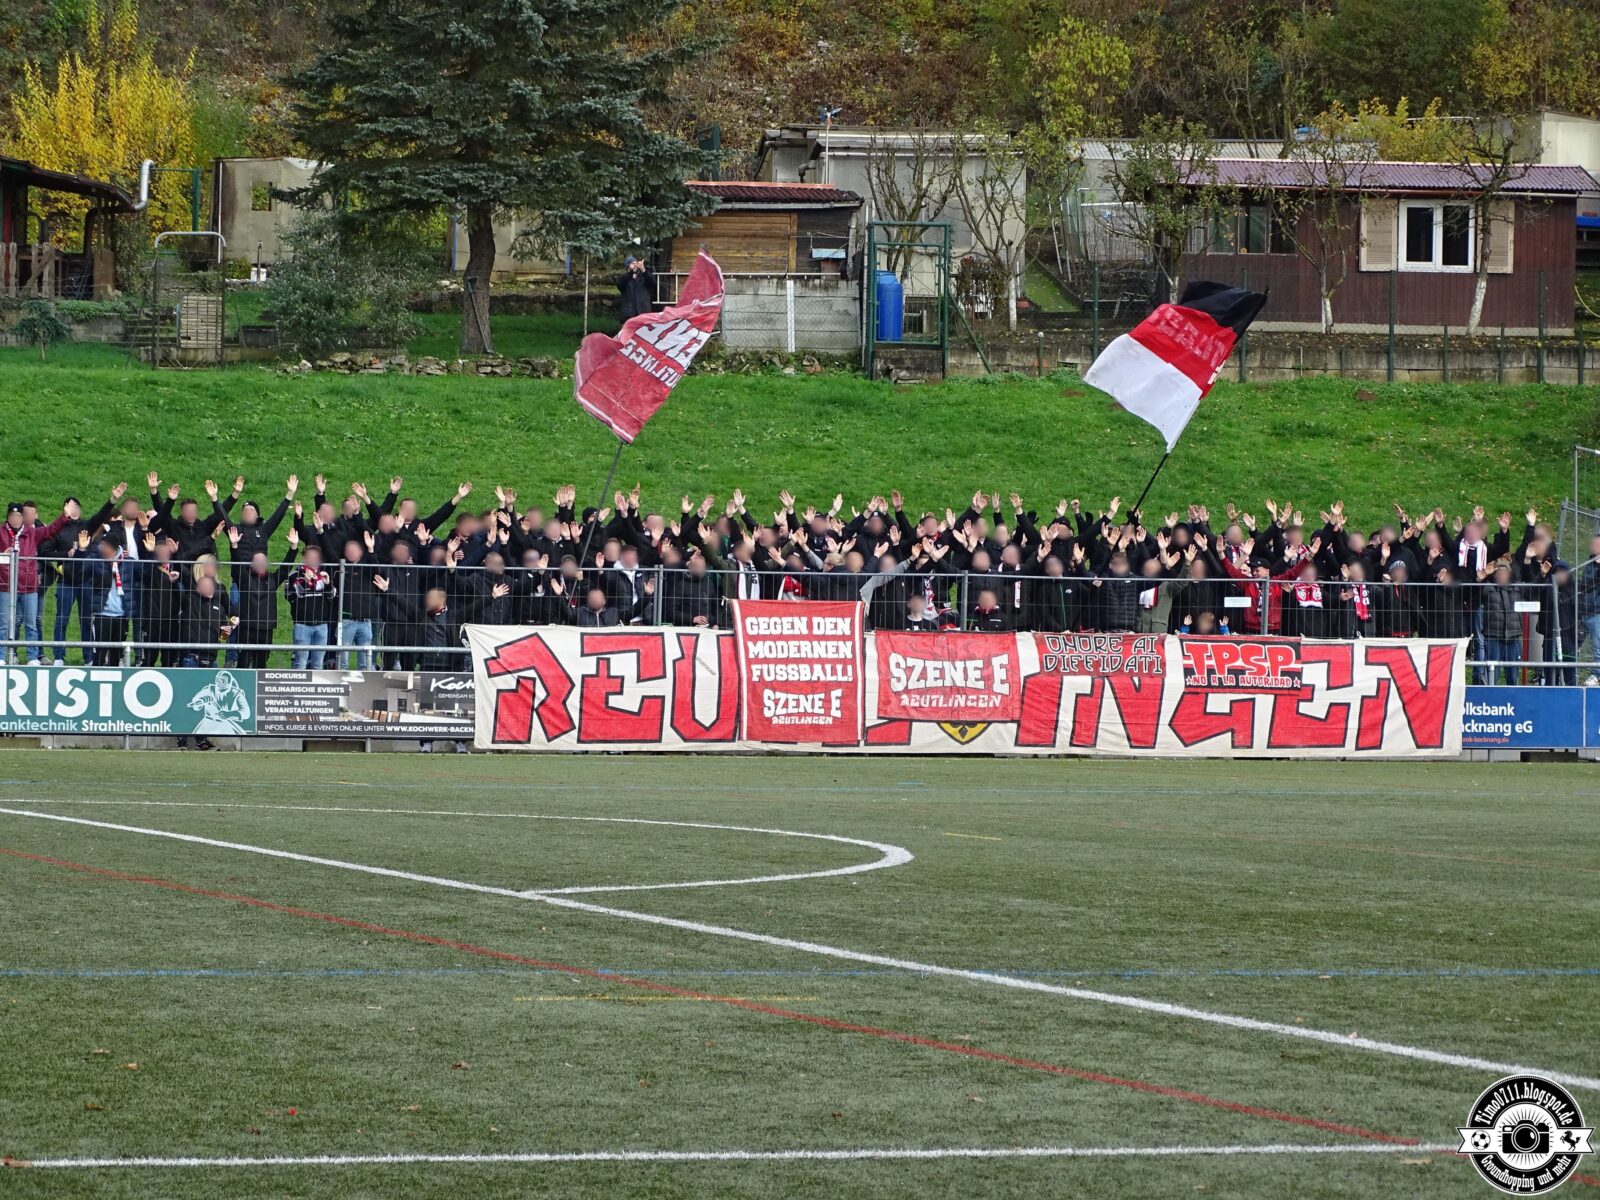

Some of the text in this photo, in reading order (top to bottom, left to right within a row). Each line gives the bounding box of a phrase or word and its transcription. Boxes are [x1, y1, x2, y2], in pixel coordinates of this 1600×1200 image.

[745, 616, 851, 635] GEGEN DEN
[747, 640, 853, 659] MODERNEN
[1045, 634, 1157, 655] ONORE AI
[1043, 653, 1162, 673] DIFFIDATI
[1183, 642, 1295, 678] TPSP
[264, 672, 307, 680] KOCHKURSE
[751, 663, 853, 682] FUSSBALL!
[889, 652, 1010, 695] SZENE E
[1192, 675, 1292, 688] NO A LA AUTORIDAD
[317, 686, 345, 694] EVENTS
[763, 688, 842, 718] SZENE E
[900, 693, 1001, 708] REUTLINGEN
[264, 706, 334, 714] VERANSTALTUNGEN
[82, 719, 172, 732] Strahltechnik
[772, 715, 833, 725] REUTLINGEN
[1515, 720, 1533, 733] eG
[386, 725, 475, 733] WWW.KOCHWERK-BACKN
